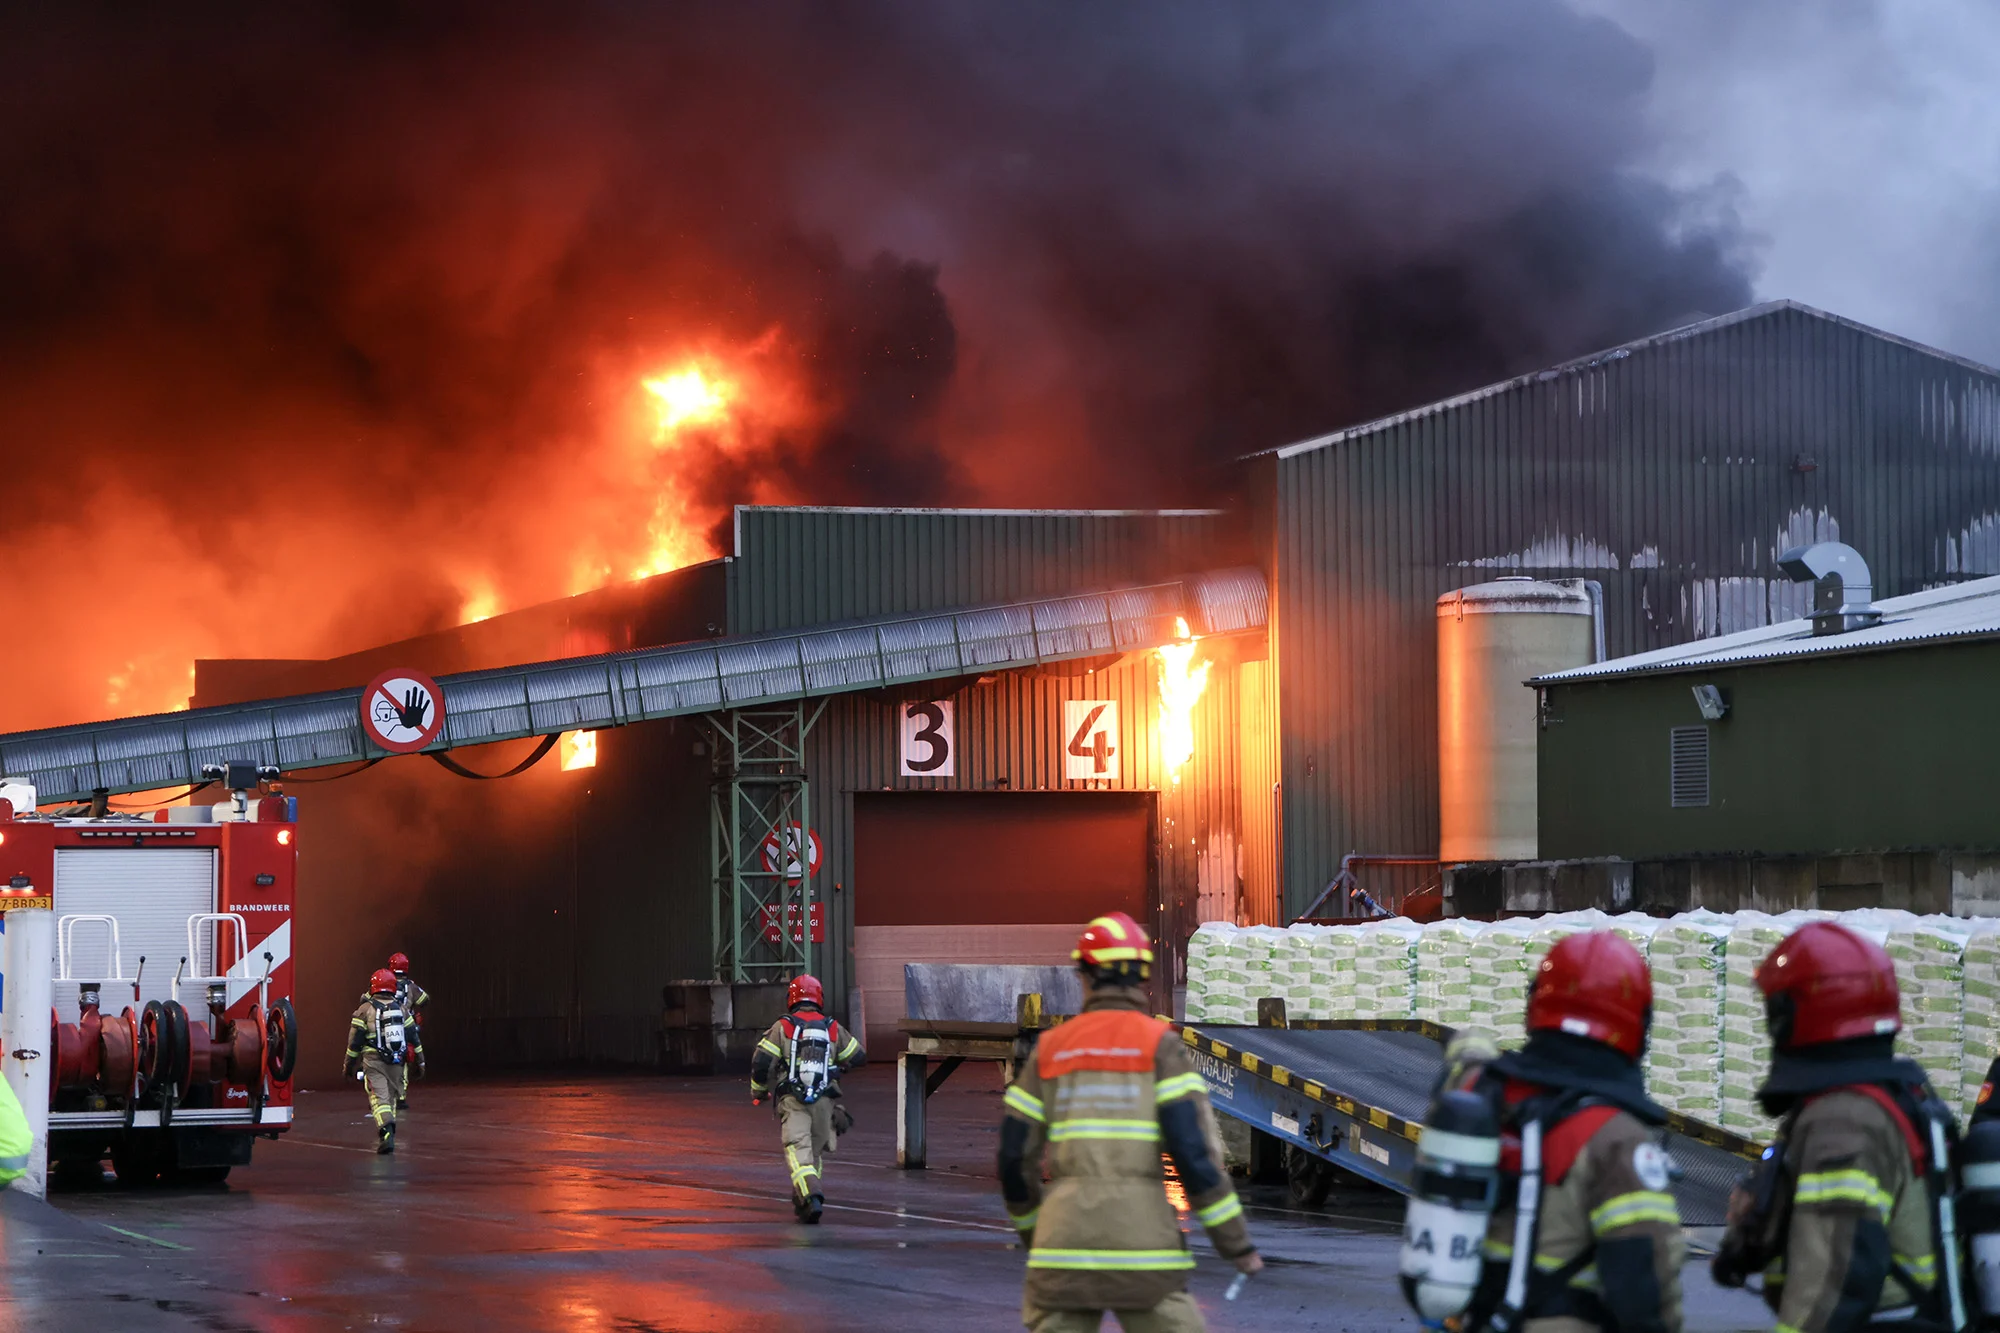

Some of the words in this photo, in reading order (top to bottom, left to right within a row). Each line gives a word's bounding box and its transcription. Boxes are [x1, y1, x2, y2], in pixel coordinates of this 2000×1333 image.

[906, 702, 949, 772] 3
[1067, 704, 1115, 773] 4
[229, 904, 290, 912] BRANDWEER
[1187, 1046, 1234, 1087] ZINGA.DE
